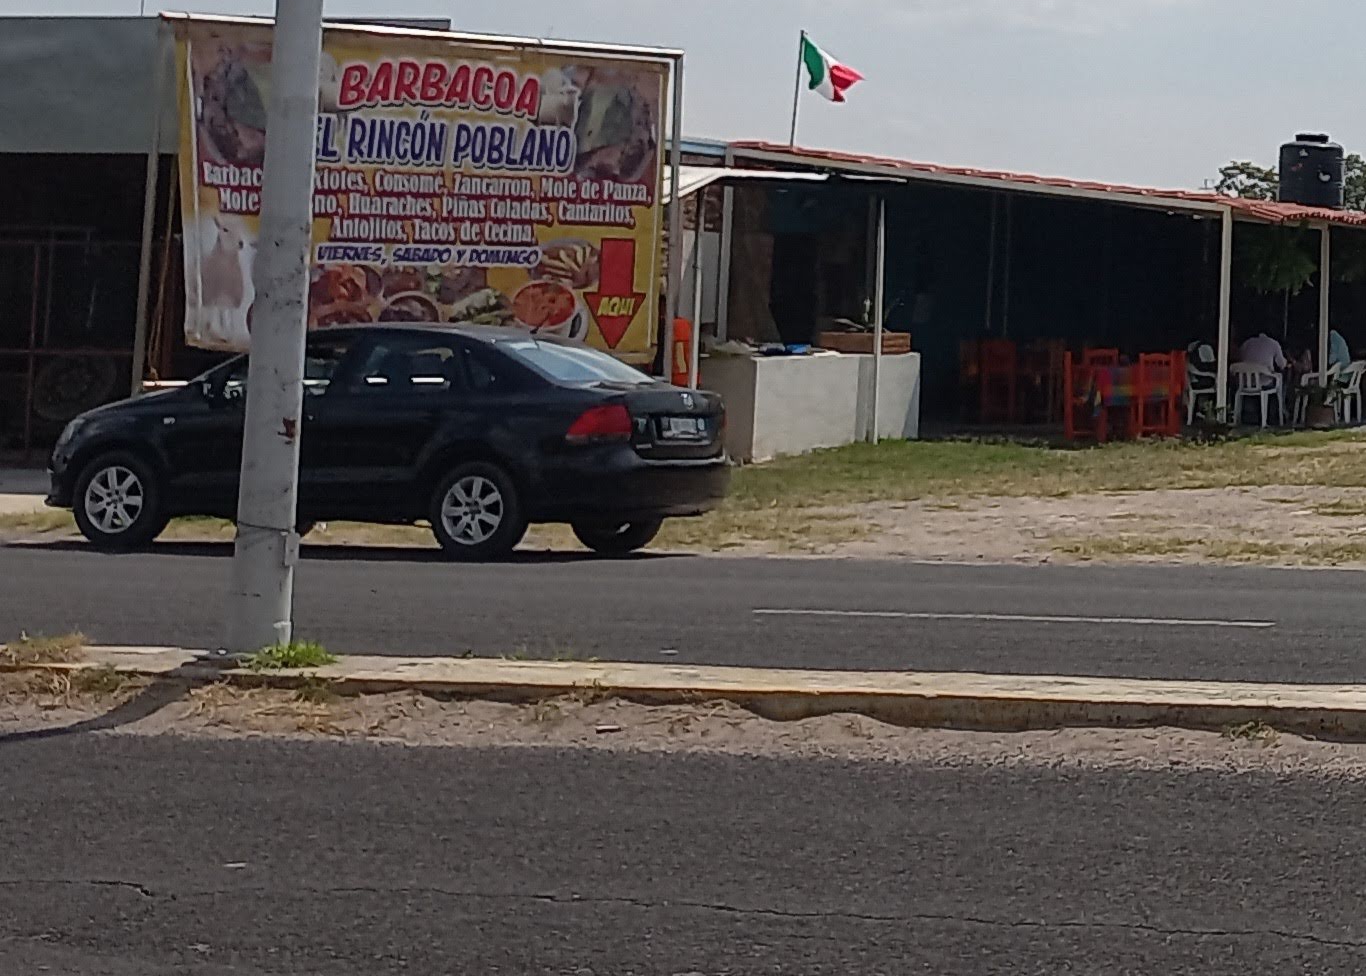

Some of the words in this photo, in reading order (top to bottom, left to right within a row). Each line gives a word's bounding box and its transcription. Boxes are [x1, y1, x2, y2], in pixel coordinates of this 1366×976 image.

[339, 61, 539, 117] BARBACOA
[348, 110, 446, 161] RINCÓN
[453, 123, 571, 167] POBLANO
[203, 161, 264, 187] Barbac
[541, 177, 577, 199] Mole
[581, 179, 600, 200] de
[603, 180, 652, 204] Panza,
[220, 187, 260, 212] Mole
[442, 196, 486, 218] Piñas
[490, 199, 552, 223] Coladas,
[413, 218, 455, 241] Tacos
[460, 220, 480, 242] de
[317, 245, 387, 265] VIERNES,
[456, 249, 467, 263] Y
[469, 248, 539, 265] DOMINGO
